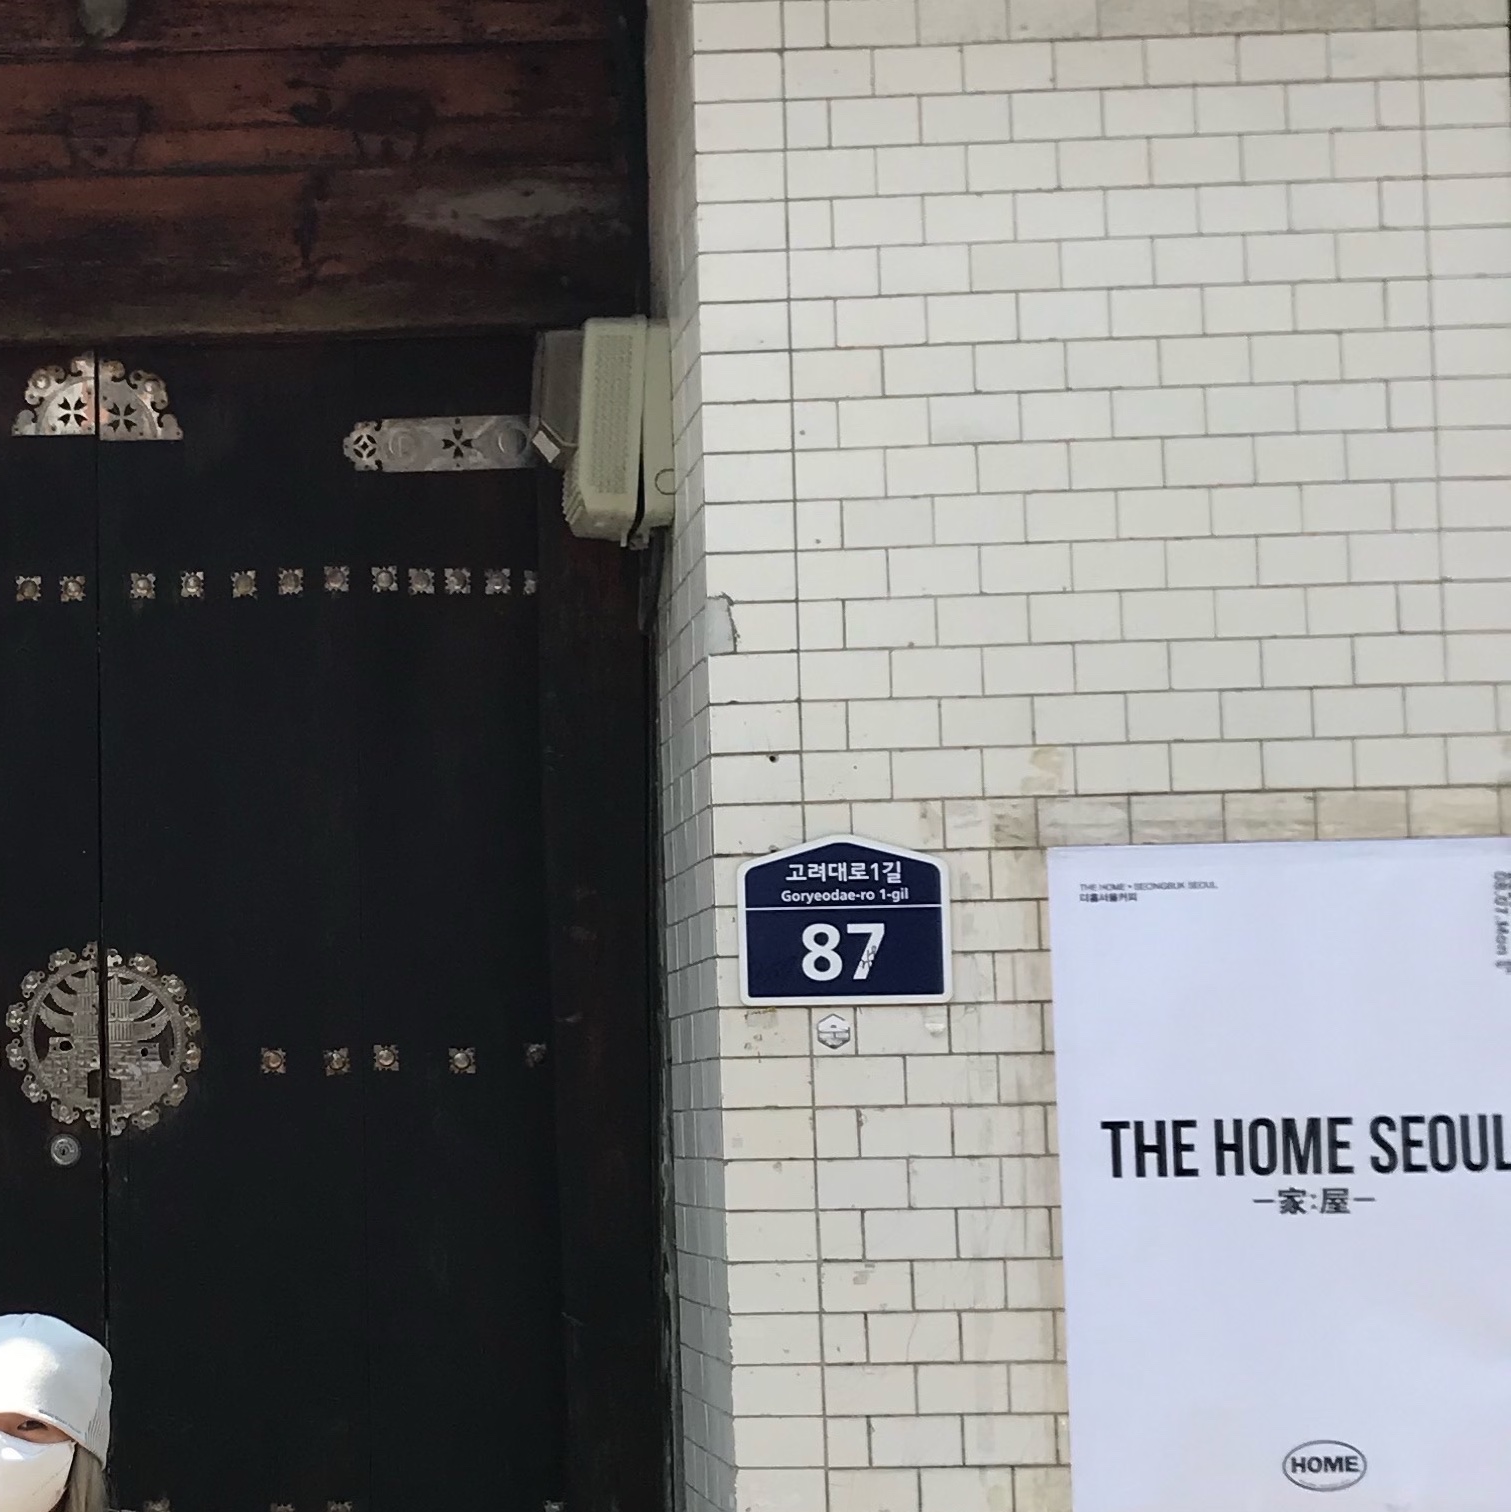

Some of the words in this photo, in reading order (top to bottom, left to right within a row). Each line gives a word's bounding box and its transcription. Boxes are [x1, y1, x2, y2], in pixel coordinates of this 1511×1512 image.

[785, 861, 902, 883] 고려대로1길
[781, 889, 875, 904] Goryeodae-ro
[879, 887, 909, 903] 1-gil
[802, 923, 885, 981] 87
[1100, 1120, 1199, 1178] THE
[1214, 1117, 1354, 1176] HOME
[1369, 1114, 1511, 1173] SEOUL
[1291, 1456, 1360, 1473] HOME
